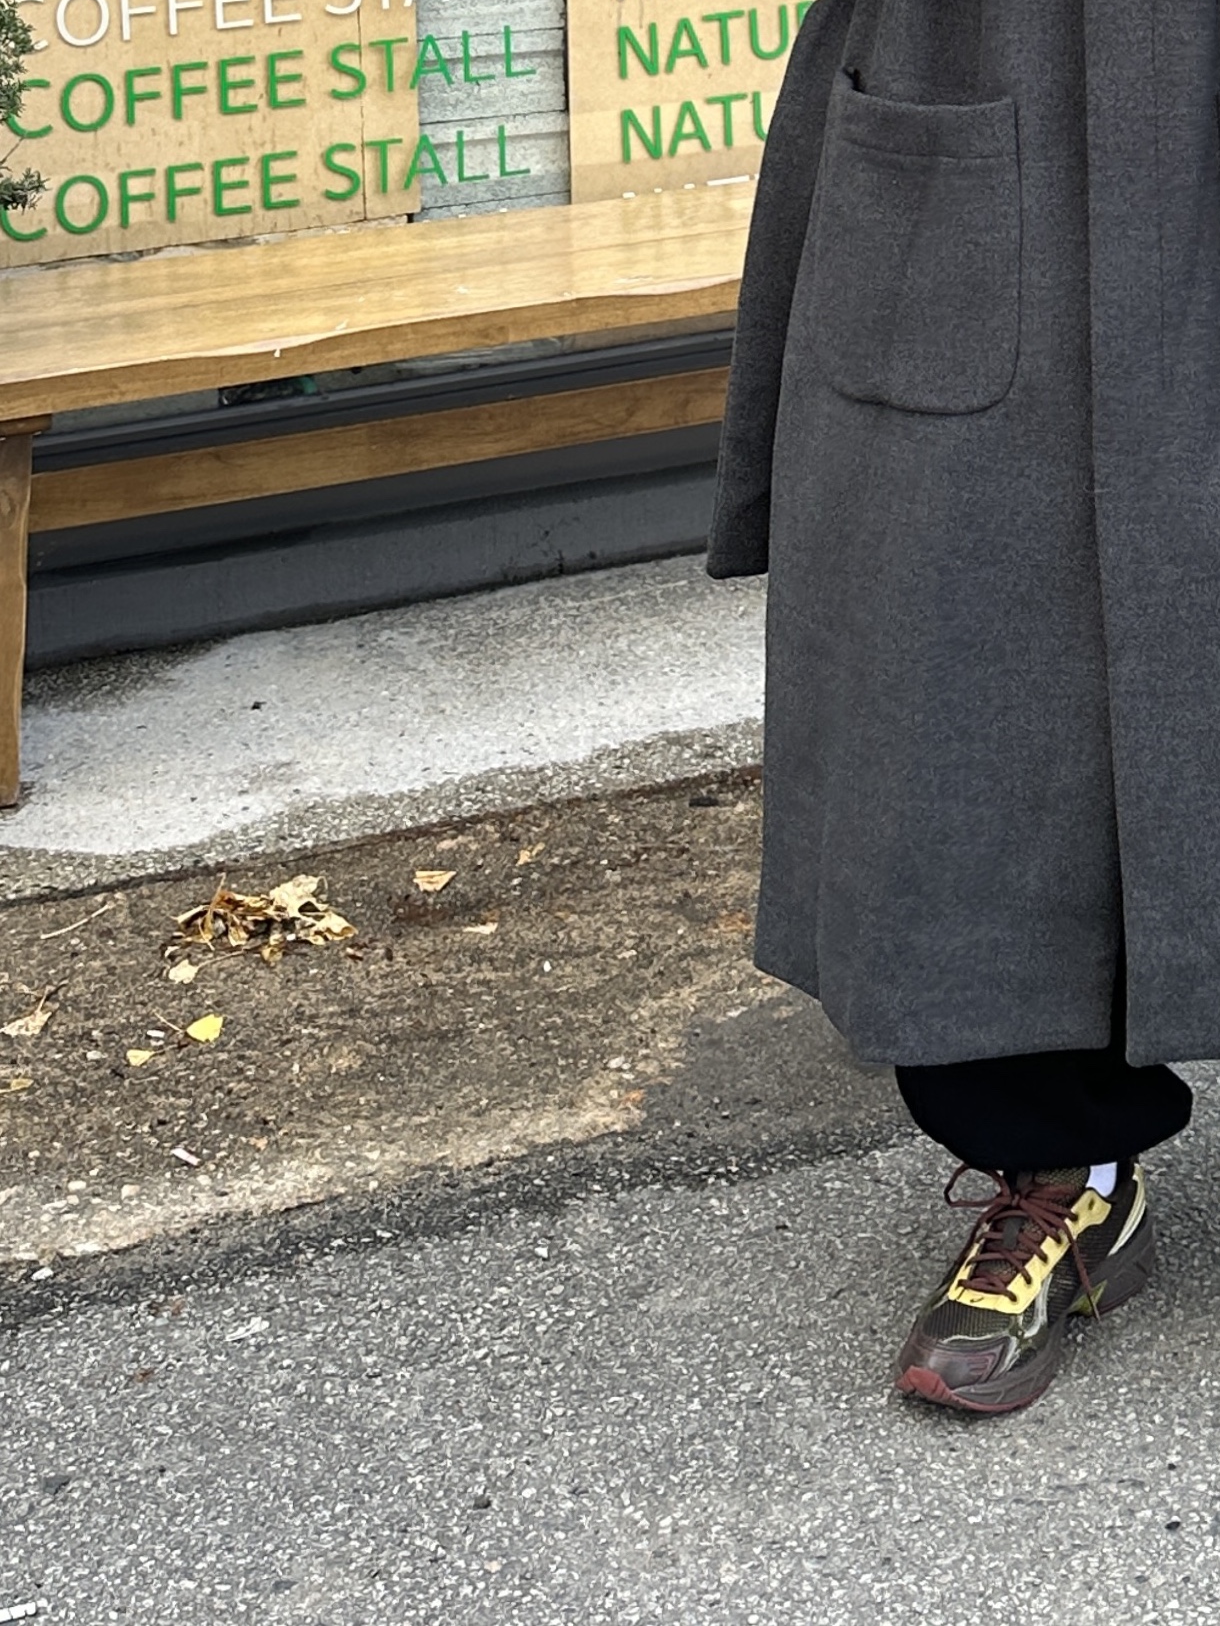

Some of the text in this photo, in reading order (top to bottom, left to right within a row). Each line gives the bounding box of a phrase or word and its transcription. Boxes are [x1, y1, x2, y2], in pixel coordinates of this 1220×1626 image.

[330, 25, 537, 100] STALL
[616, 0, 813, 80] NATU
[324, 125, 531, 202] STALL
